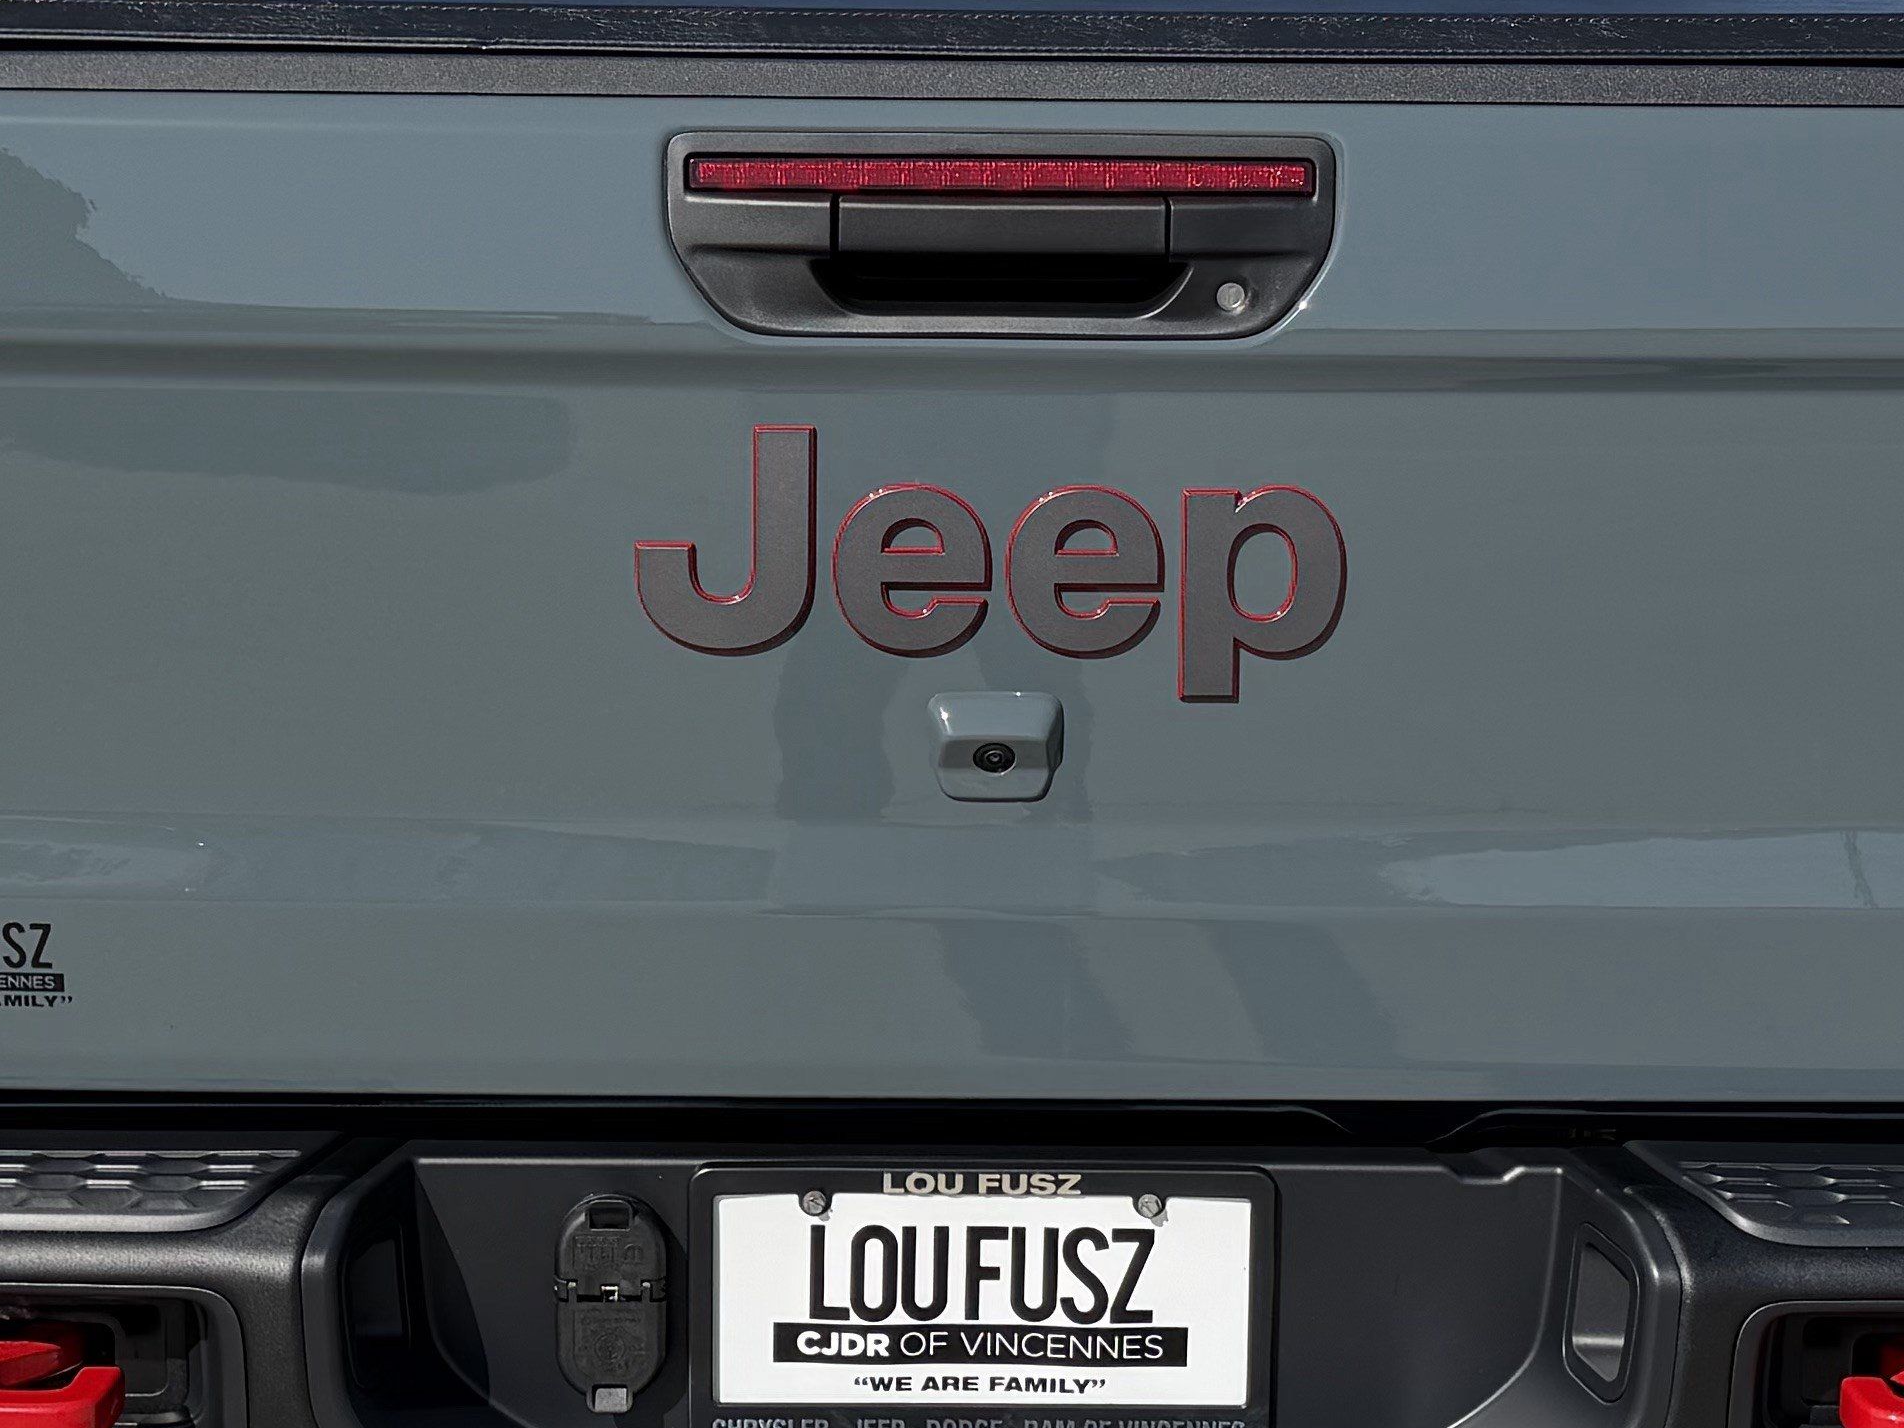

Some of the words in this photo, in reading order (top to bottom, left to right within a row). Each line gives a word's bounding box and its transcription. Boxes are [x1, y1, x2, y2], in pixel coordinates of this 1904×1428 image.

[634, 423, 1348, 703] Jeep
[882, 1172, 964, 1195] LOU
[978, 1173, 1082, 1195] FUSZ
[796, 1330, 890, 1356] CJDR
[899, 1331, 949, 1356] OF
[959, 1332, 1164, 1359] VINCENNES
[921, 1376, 979, 1392] ARE
